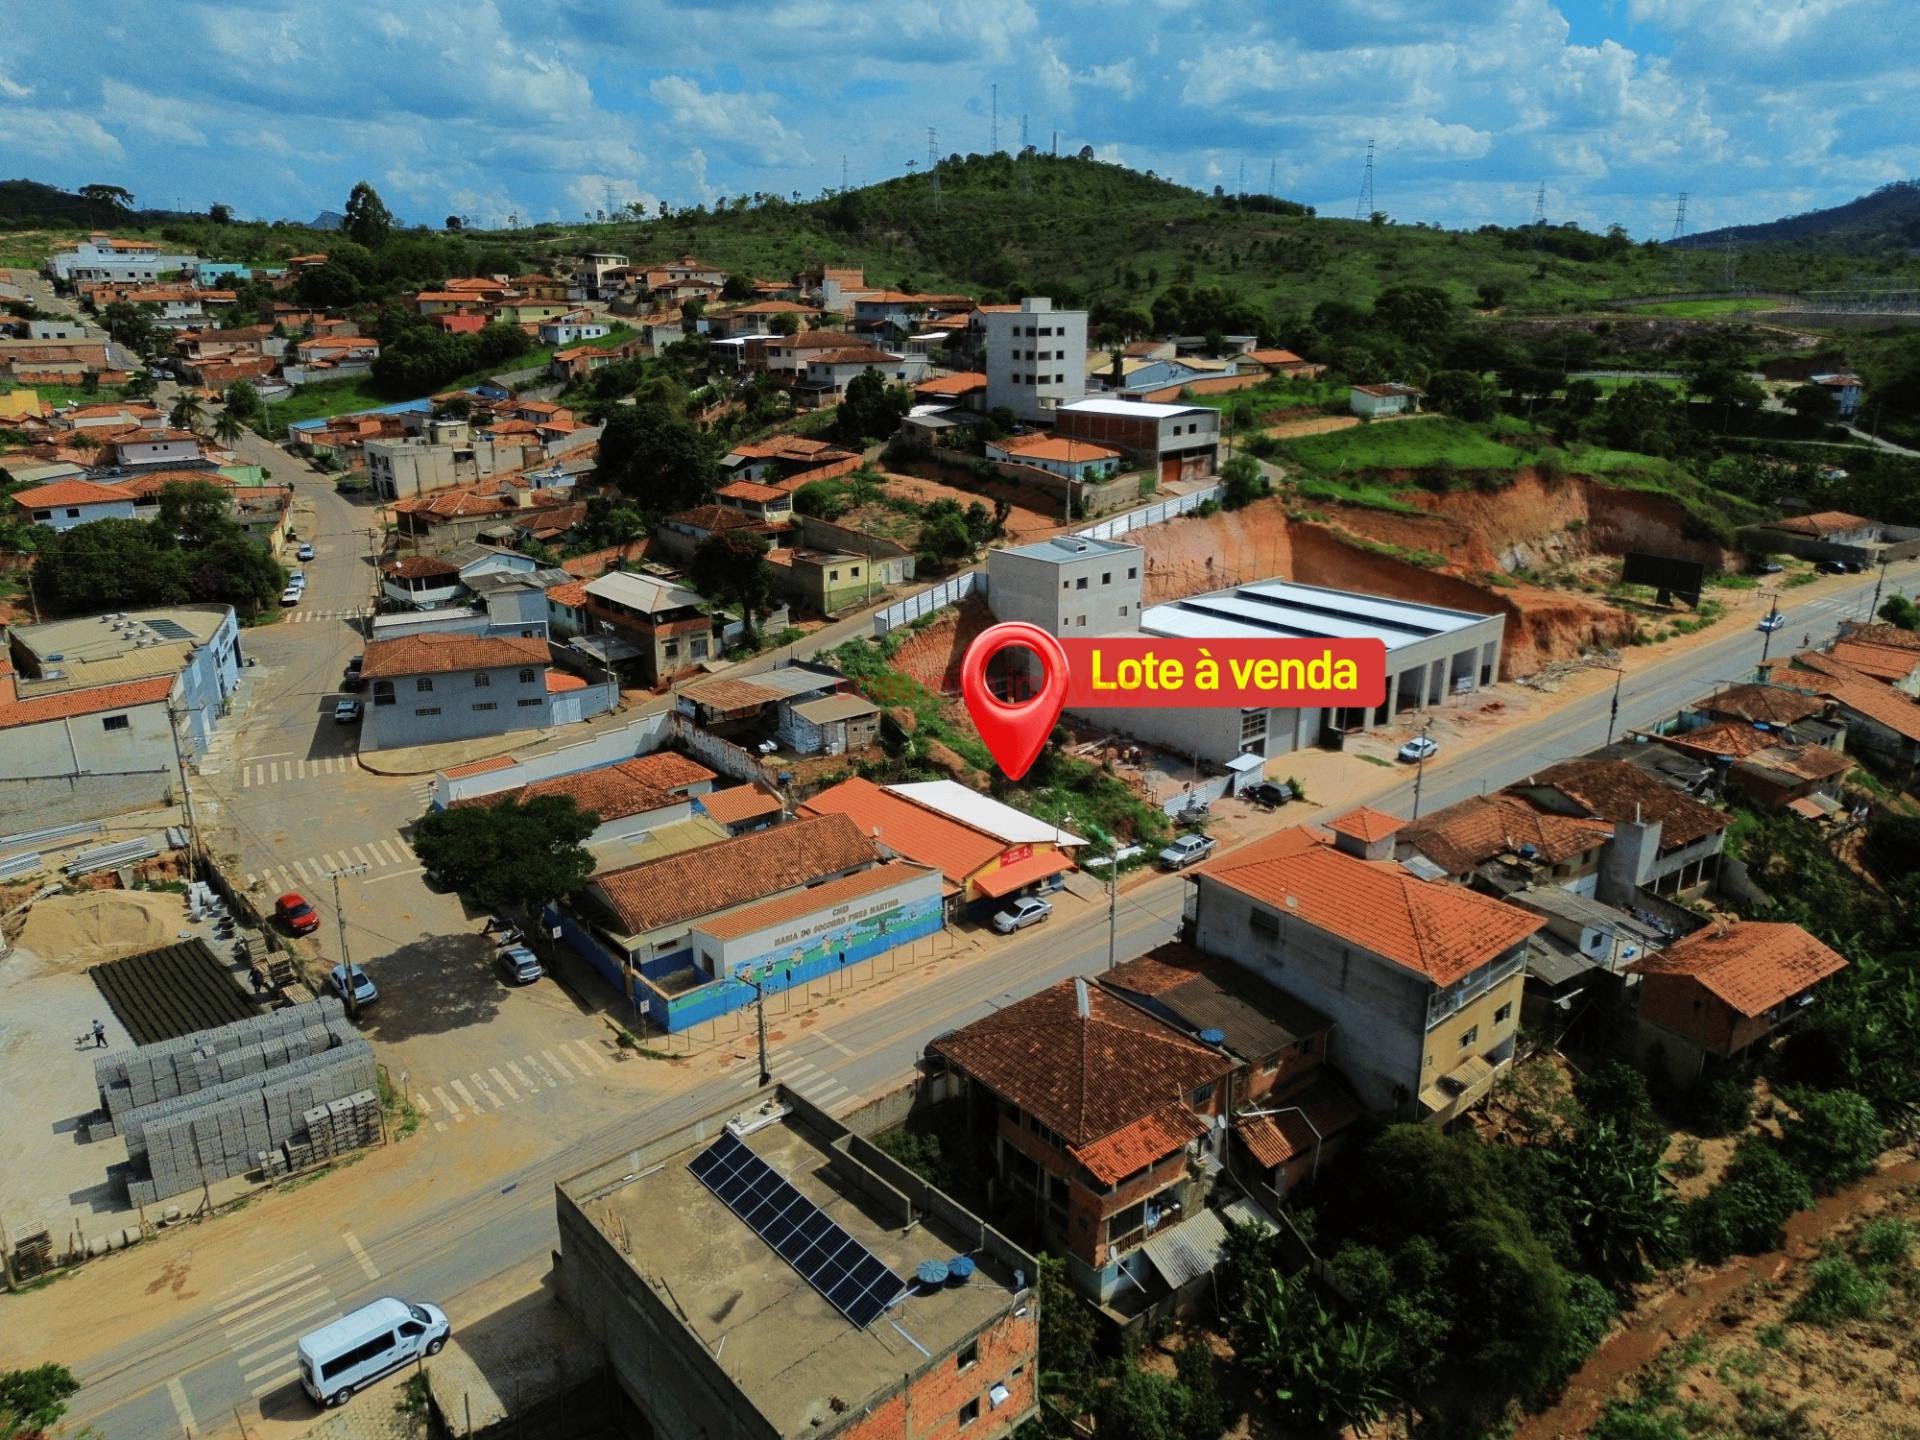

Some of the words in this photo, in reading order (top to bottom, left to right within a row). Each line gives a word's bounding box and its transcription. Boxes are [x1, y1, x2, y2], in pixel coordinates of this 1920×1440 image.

[774, 932, 798, 946] MARIA
[801, 928, 811, 937] DO
[814, 917, 846, 934] SOCORRO
[848, 909, 868, 922] PIRES
